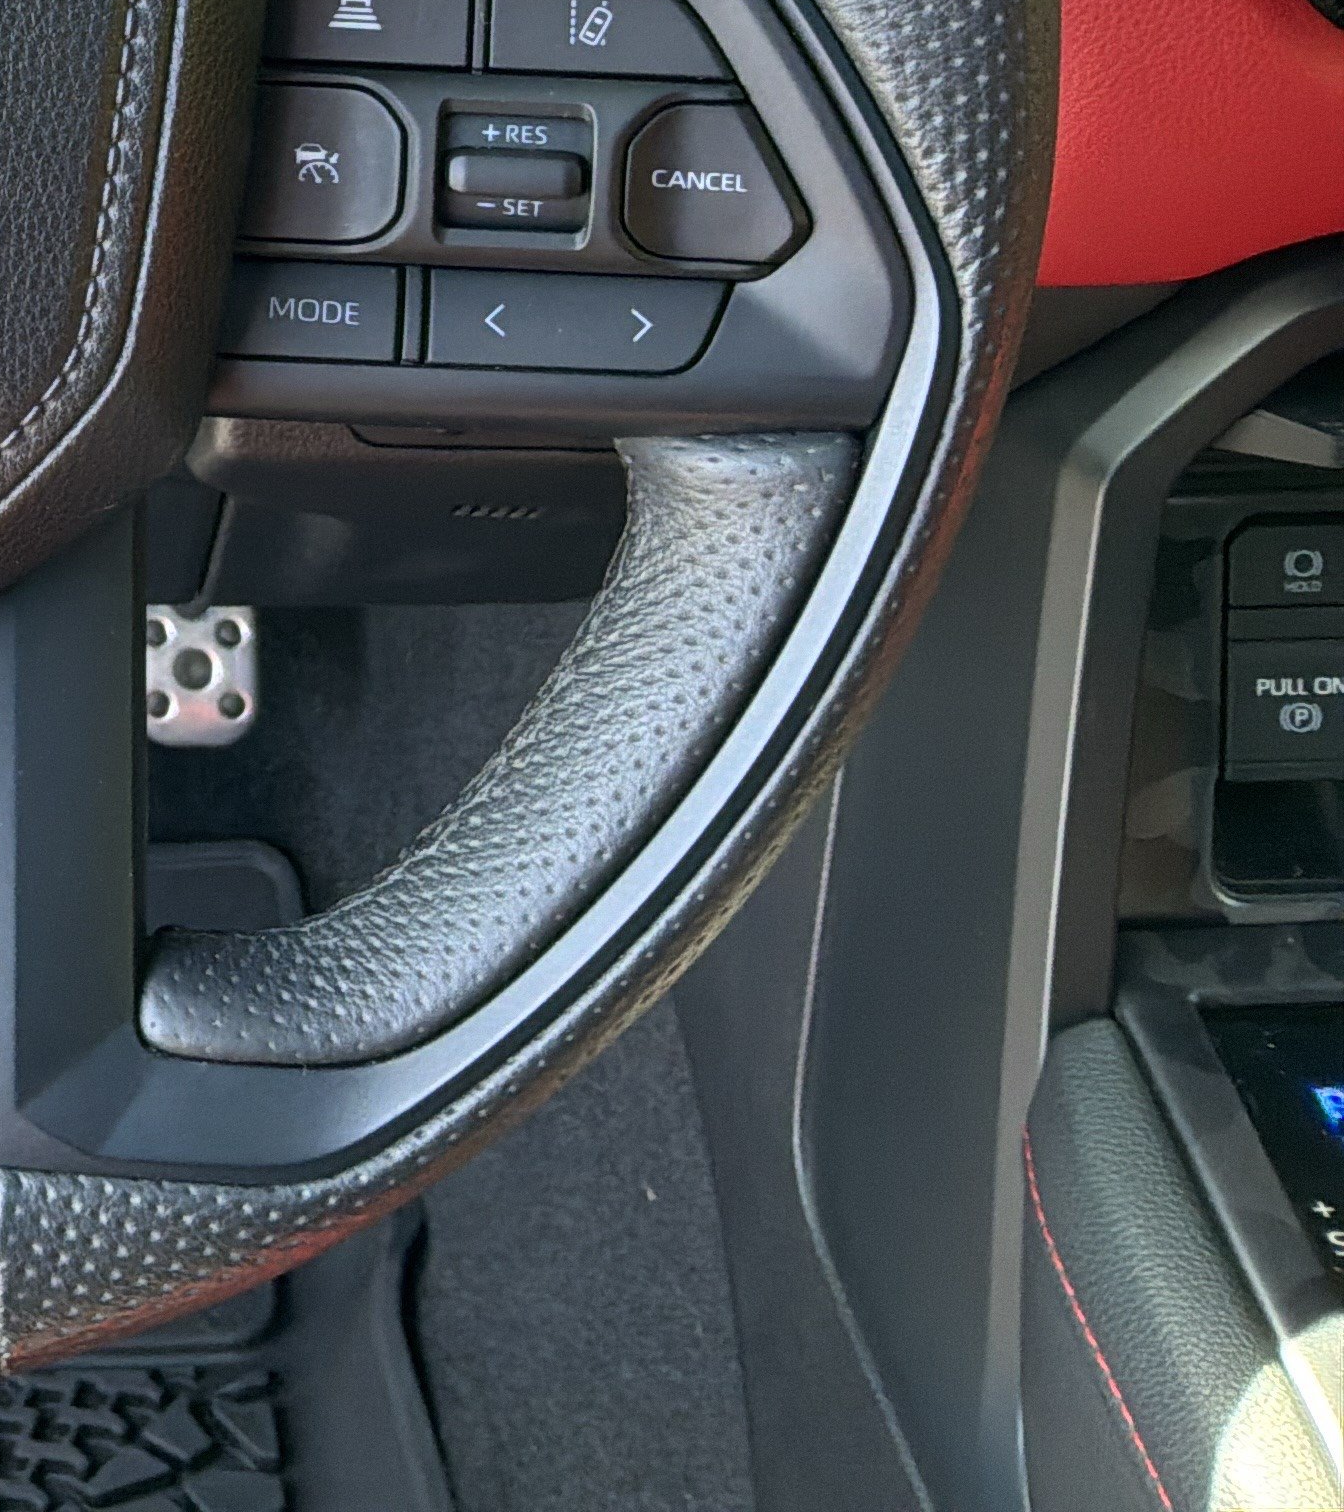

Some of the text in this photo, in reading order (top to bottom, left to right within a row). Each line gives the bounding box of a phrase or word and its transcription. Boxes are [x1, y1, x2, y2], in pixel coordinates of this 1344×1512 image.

[650, 168, 747, 194] CANCEL
[268, 296, 360, 326] MODE
[1255, 677, 1309, 697] PULL
